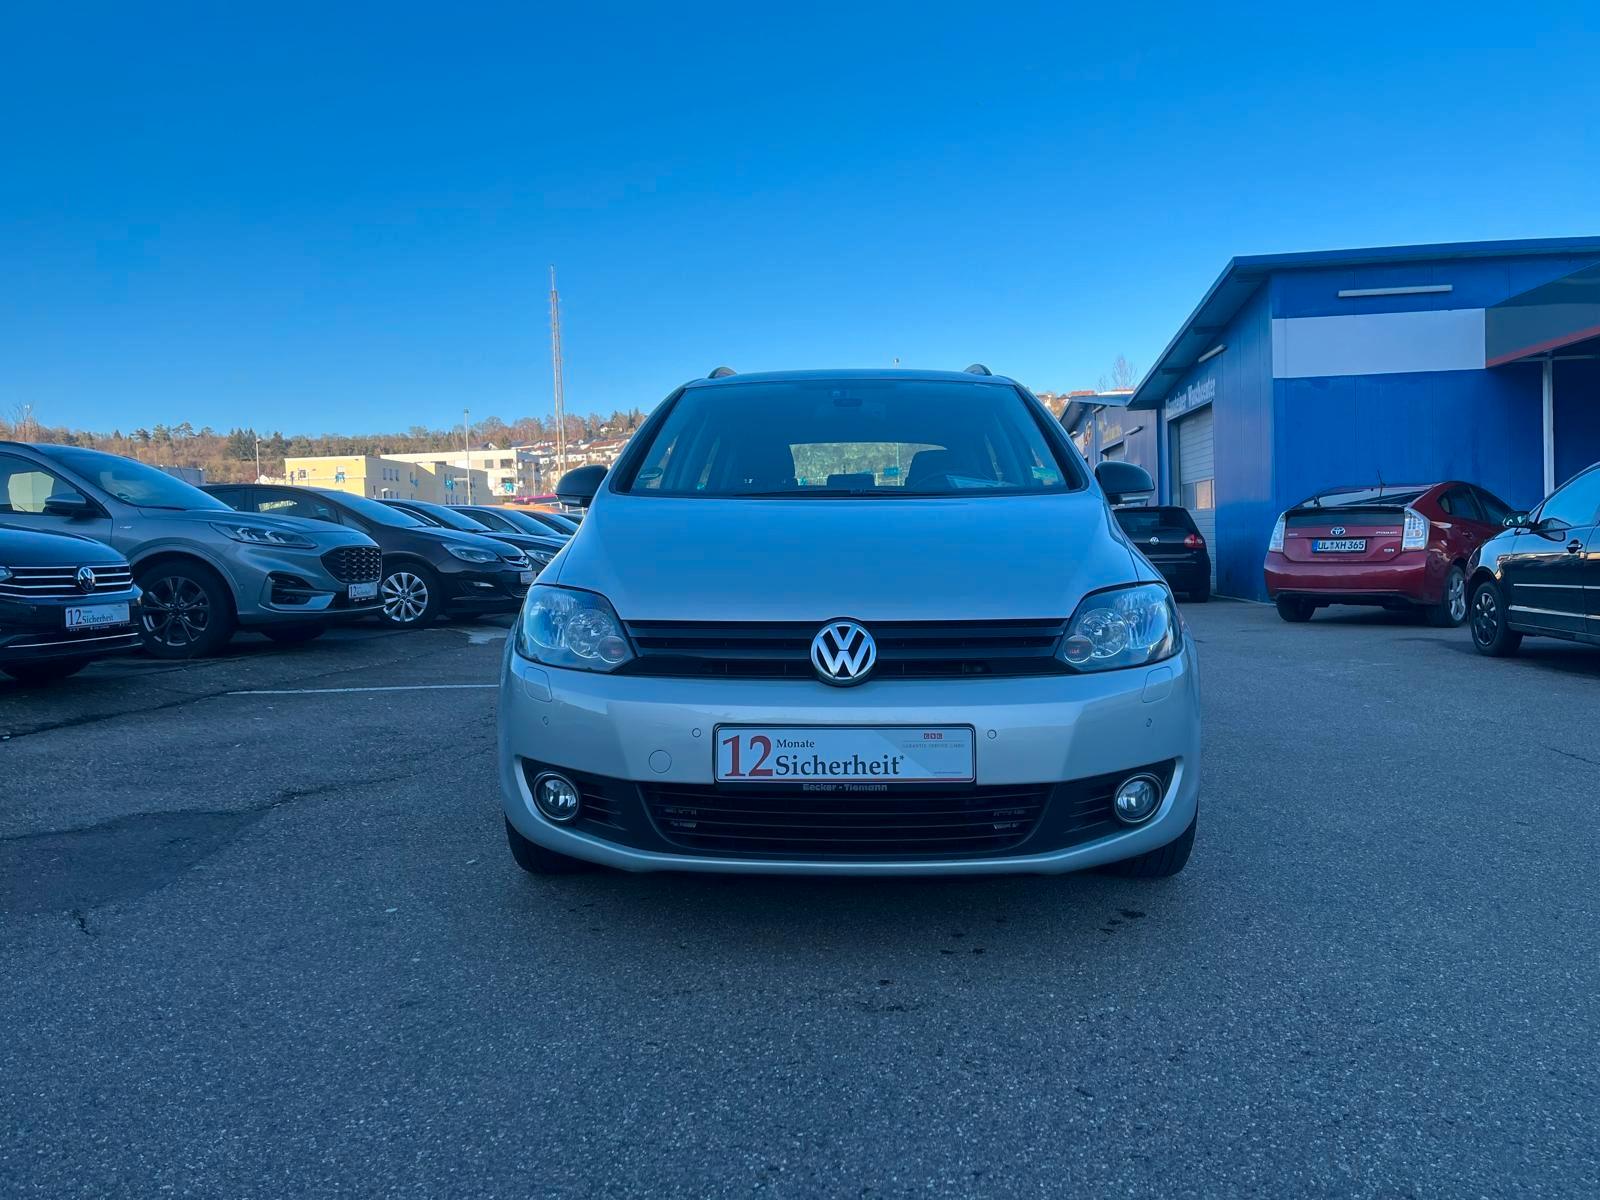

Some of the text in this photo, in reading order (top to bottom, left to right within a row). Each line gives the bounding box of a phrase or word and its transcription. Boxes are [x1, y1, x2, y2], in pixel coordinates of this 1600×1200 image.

[1334, 541, 1347, 550] XH
[1347, 541, 1365, 550] 365
[67, 608, 82, 626] 12
[776, 738, 815, 749] Monate
[722, 734, 774, 777] 12
